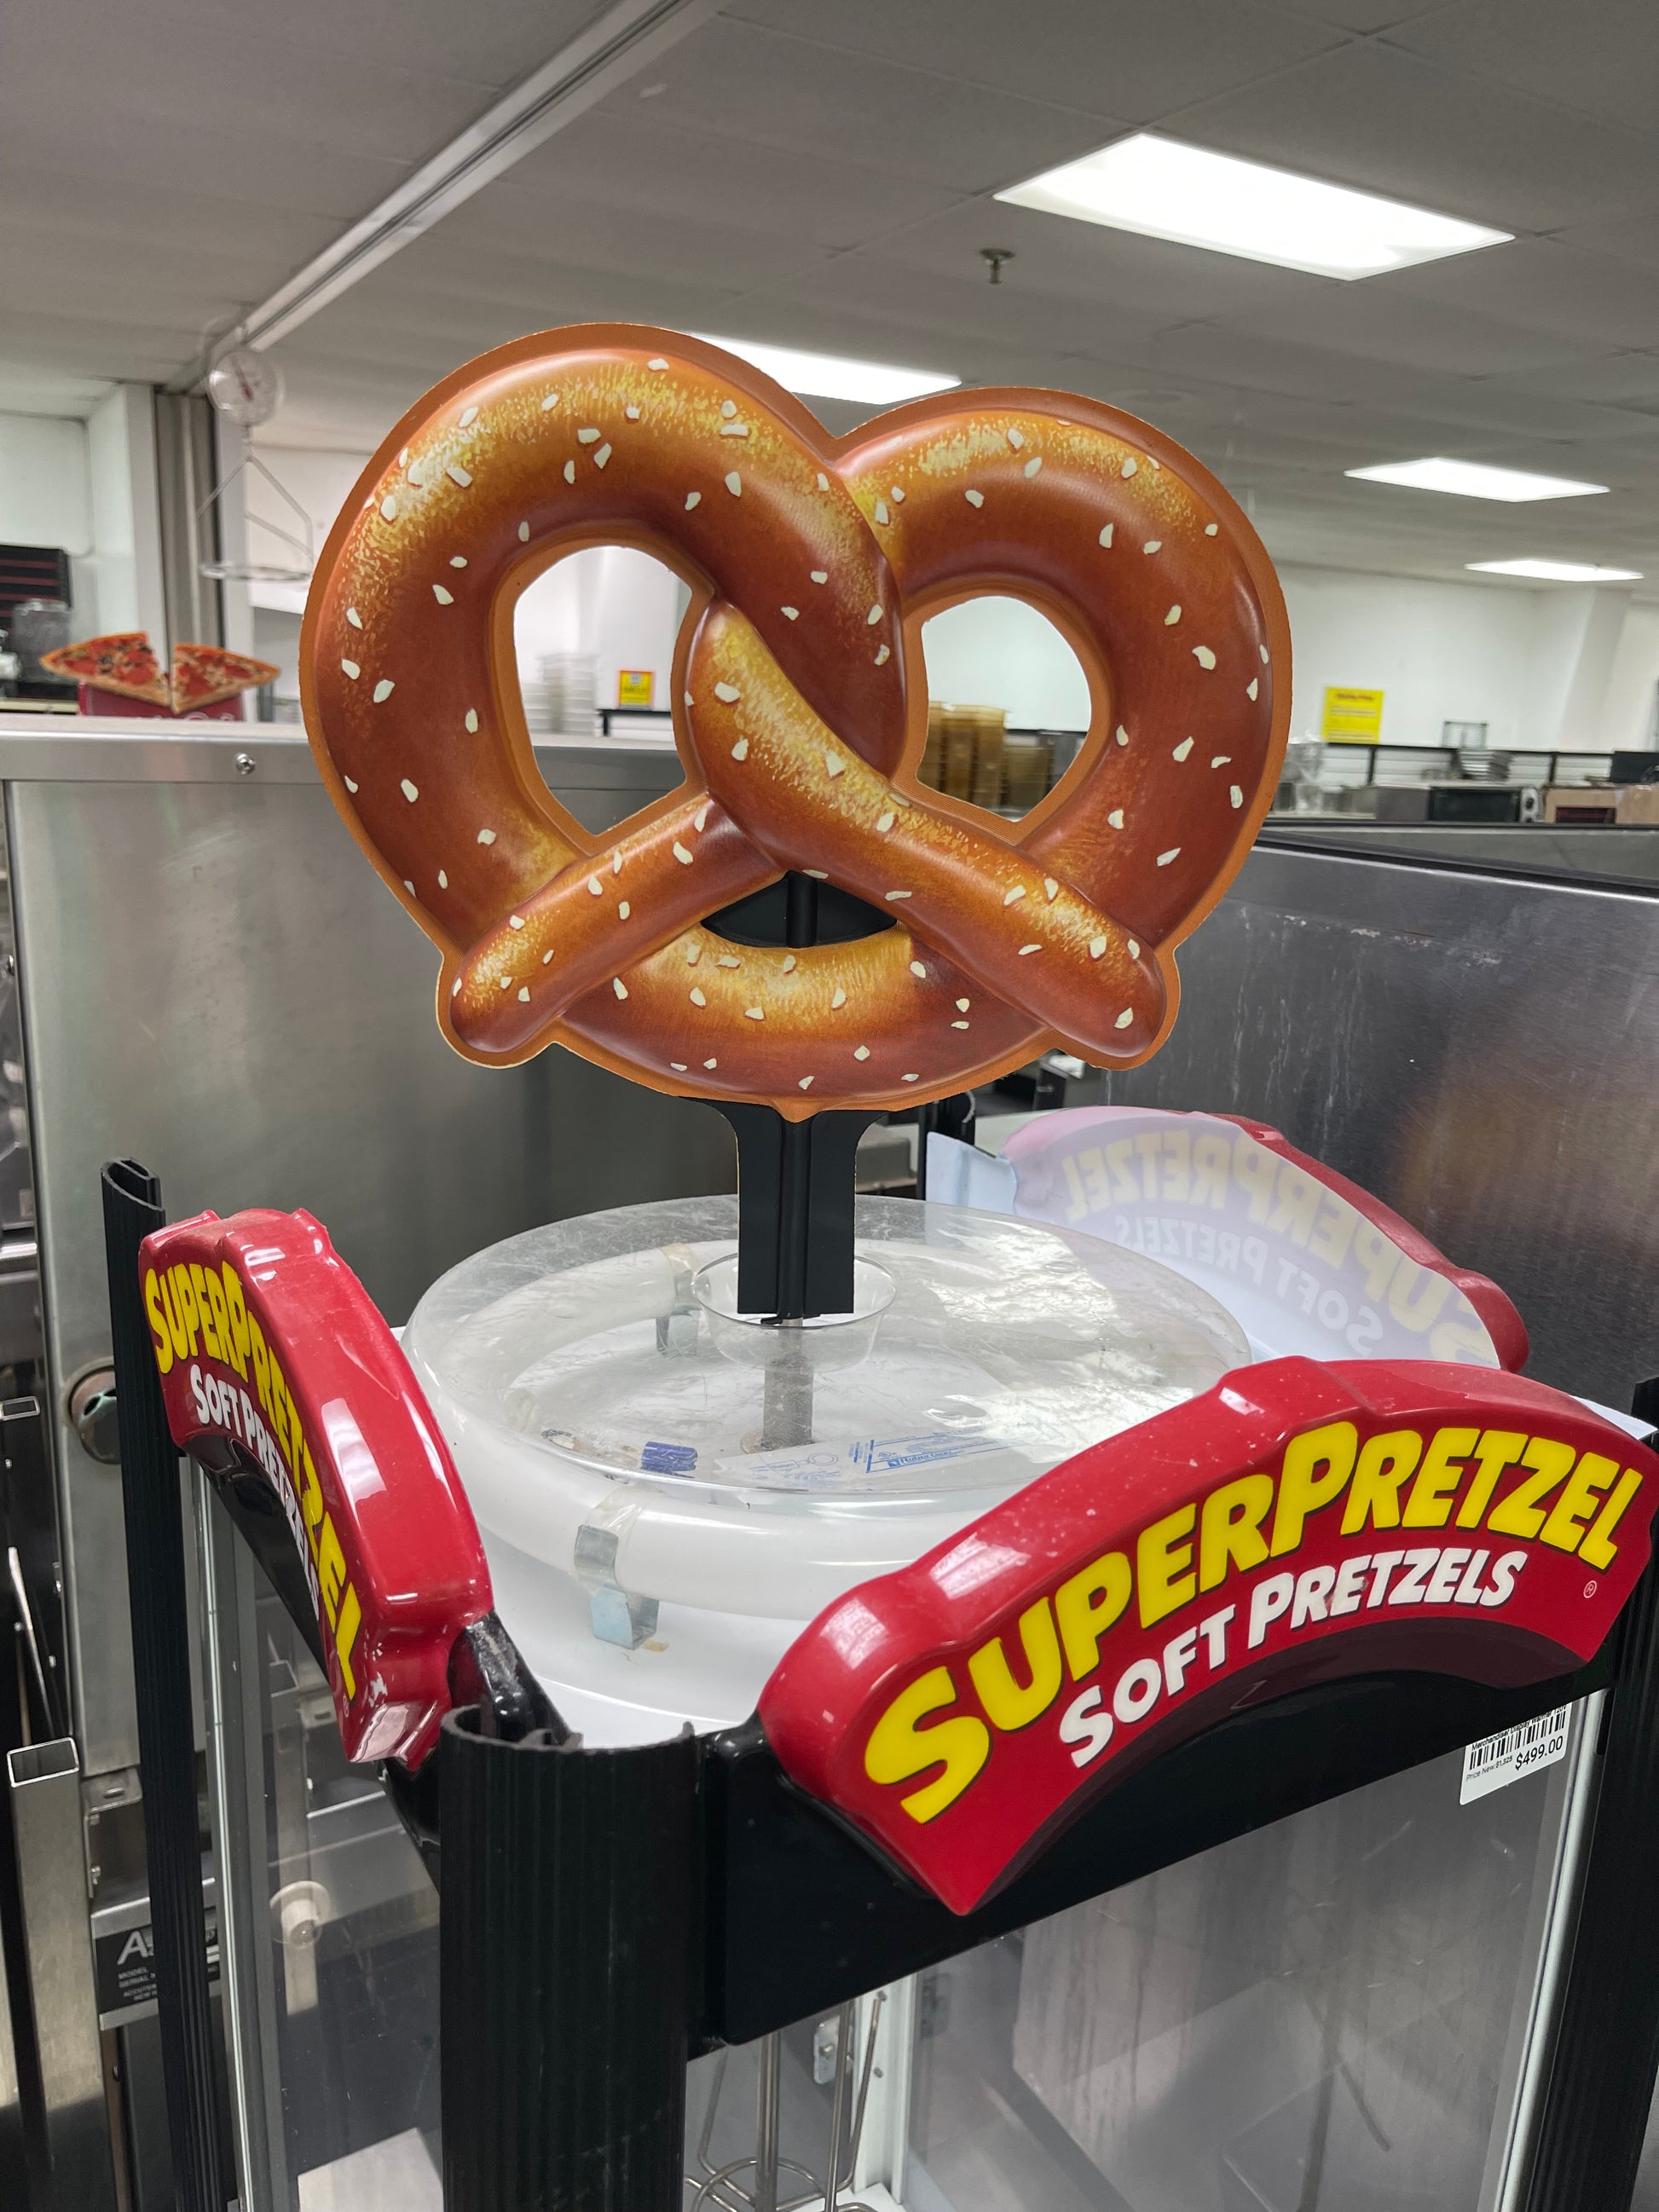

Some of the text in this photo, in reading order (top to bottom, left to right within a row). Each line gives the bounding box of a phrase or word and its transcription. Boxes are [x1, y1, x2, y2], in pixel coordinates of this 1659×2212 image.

[190, 1364, 243, 1438] SOFT
[864, 1421, 1644, 1825] SUPERPRETZEL
[1059, 1546, 1529, 1769] SOFT PRETZELS
[1466, 1770, 1481, 1782] Price
[1515, 1736, 1564, 1770] $499.00
